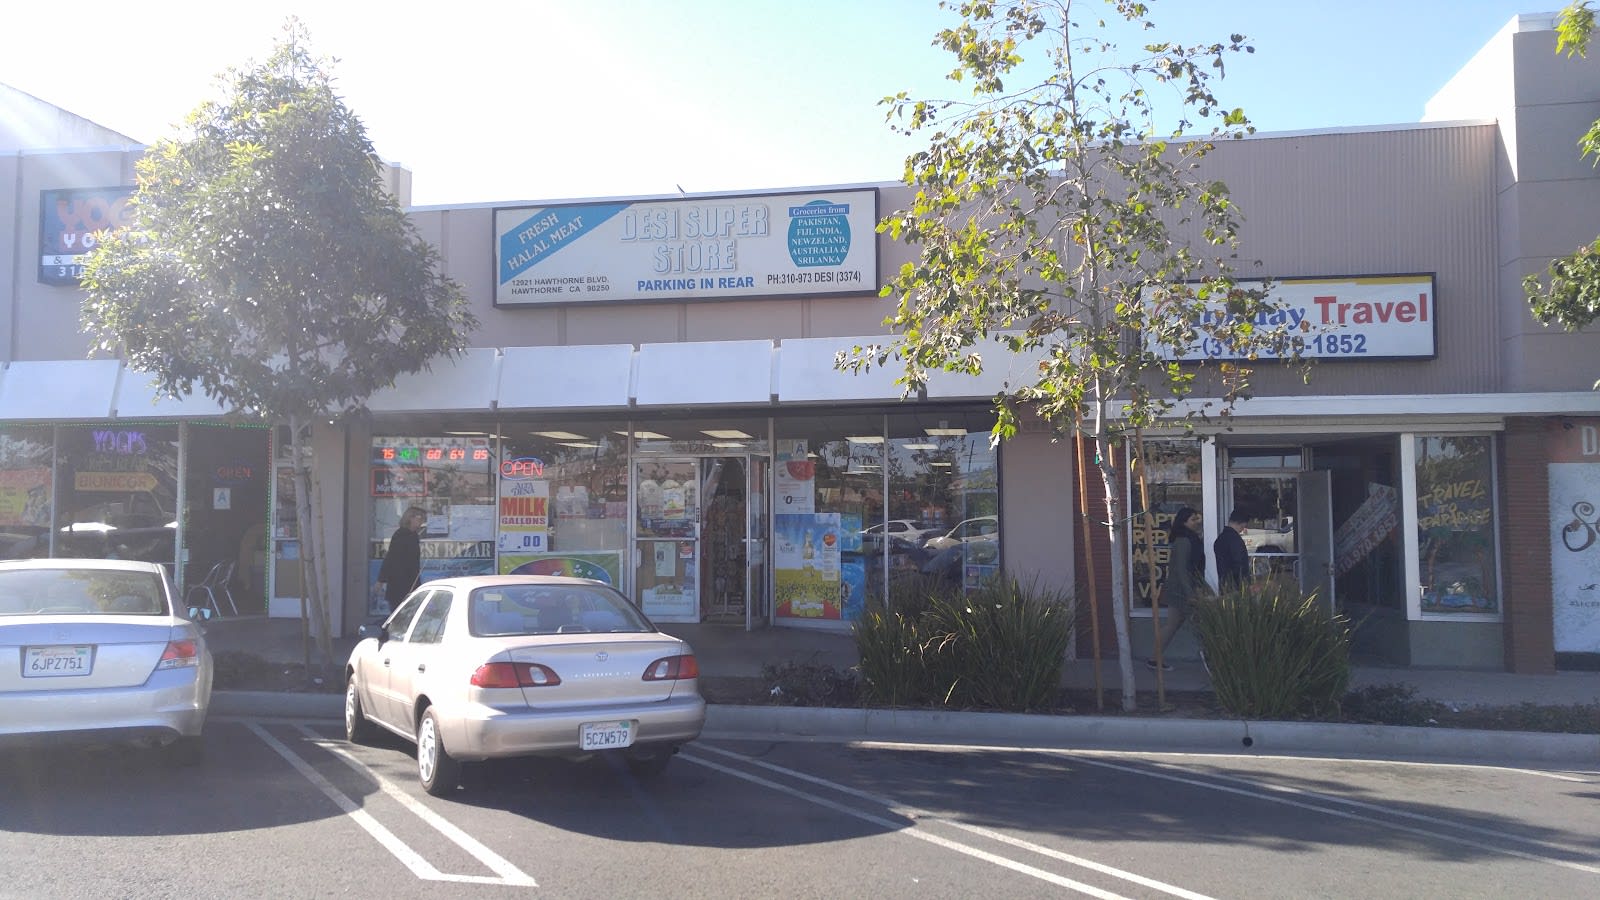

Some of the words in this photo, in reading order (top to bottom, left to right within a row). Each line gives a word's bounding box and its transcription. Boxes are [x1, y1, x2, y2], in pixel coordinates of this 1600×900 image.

[793, 207, 827, 216] Groceries
[828, 205, 846, 214] from
[620, 207, 680, 241] DESI
[685, 203, 770, 238] SUPER
[798, 217, 841, 227] PAKISTAN,
[518, 213, 560, 244] FRESH
[796, 228, 814, 236] FIJI,
[816, 226, 842, 235] INDIA,
[507, 239, 550, 271] HALAL
[549, 215, 584, 245] MEAT
[791, 236, 847, 246] NEWZELAND,
[791, 246, 839, 256] AUSTRALIA
[840, 245, 848, 253] &
[653, 239, 737, 274] STORE
[798, 255, 841, 264] SRILANKA
[534, 277, 585, 286] HAWTHORNE
[767, 273, 812, 284] PH:310-973
[814, 271, 834, 283] DESI
[836, 270, 861, 285] (3374)
[511, 286, 563, 295] HAWTHORNE
[569, 285, 581, 293] CA
[586, 284, 610, 293] 90250
[637, 278, 695, 292] PARKING
[700, 277, 714, 289] IN
[718, 276, 754, 289] REAR
[1313, 293, 1428, 325] Travel
[796, 443, 804, 454] A
[426, 449, 442, 460] 60
[472, 449, 489, 460] 85
[500, 460, 545, 476] OPEN
[217, 491, 227, 503] A
[1418, 480, 1486, 509] TRAVEL
[501, 497, 546, 516] MILK
[1439, 503, 1457, 514] TO
[501, 517, 546, 525] GALLONS
[31, 657, 83, 671] 6JPZ751
[585, 729, 628, 746] 5CZW579
